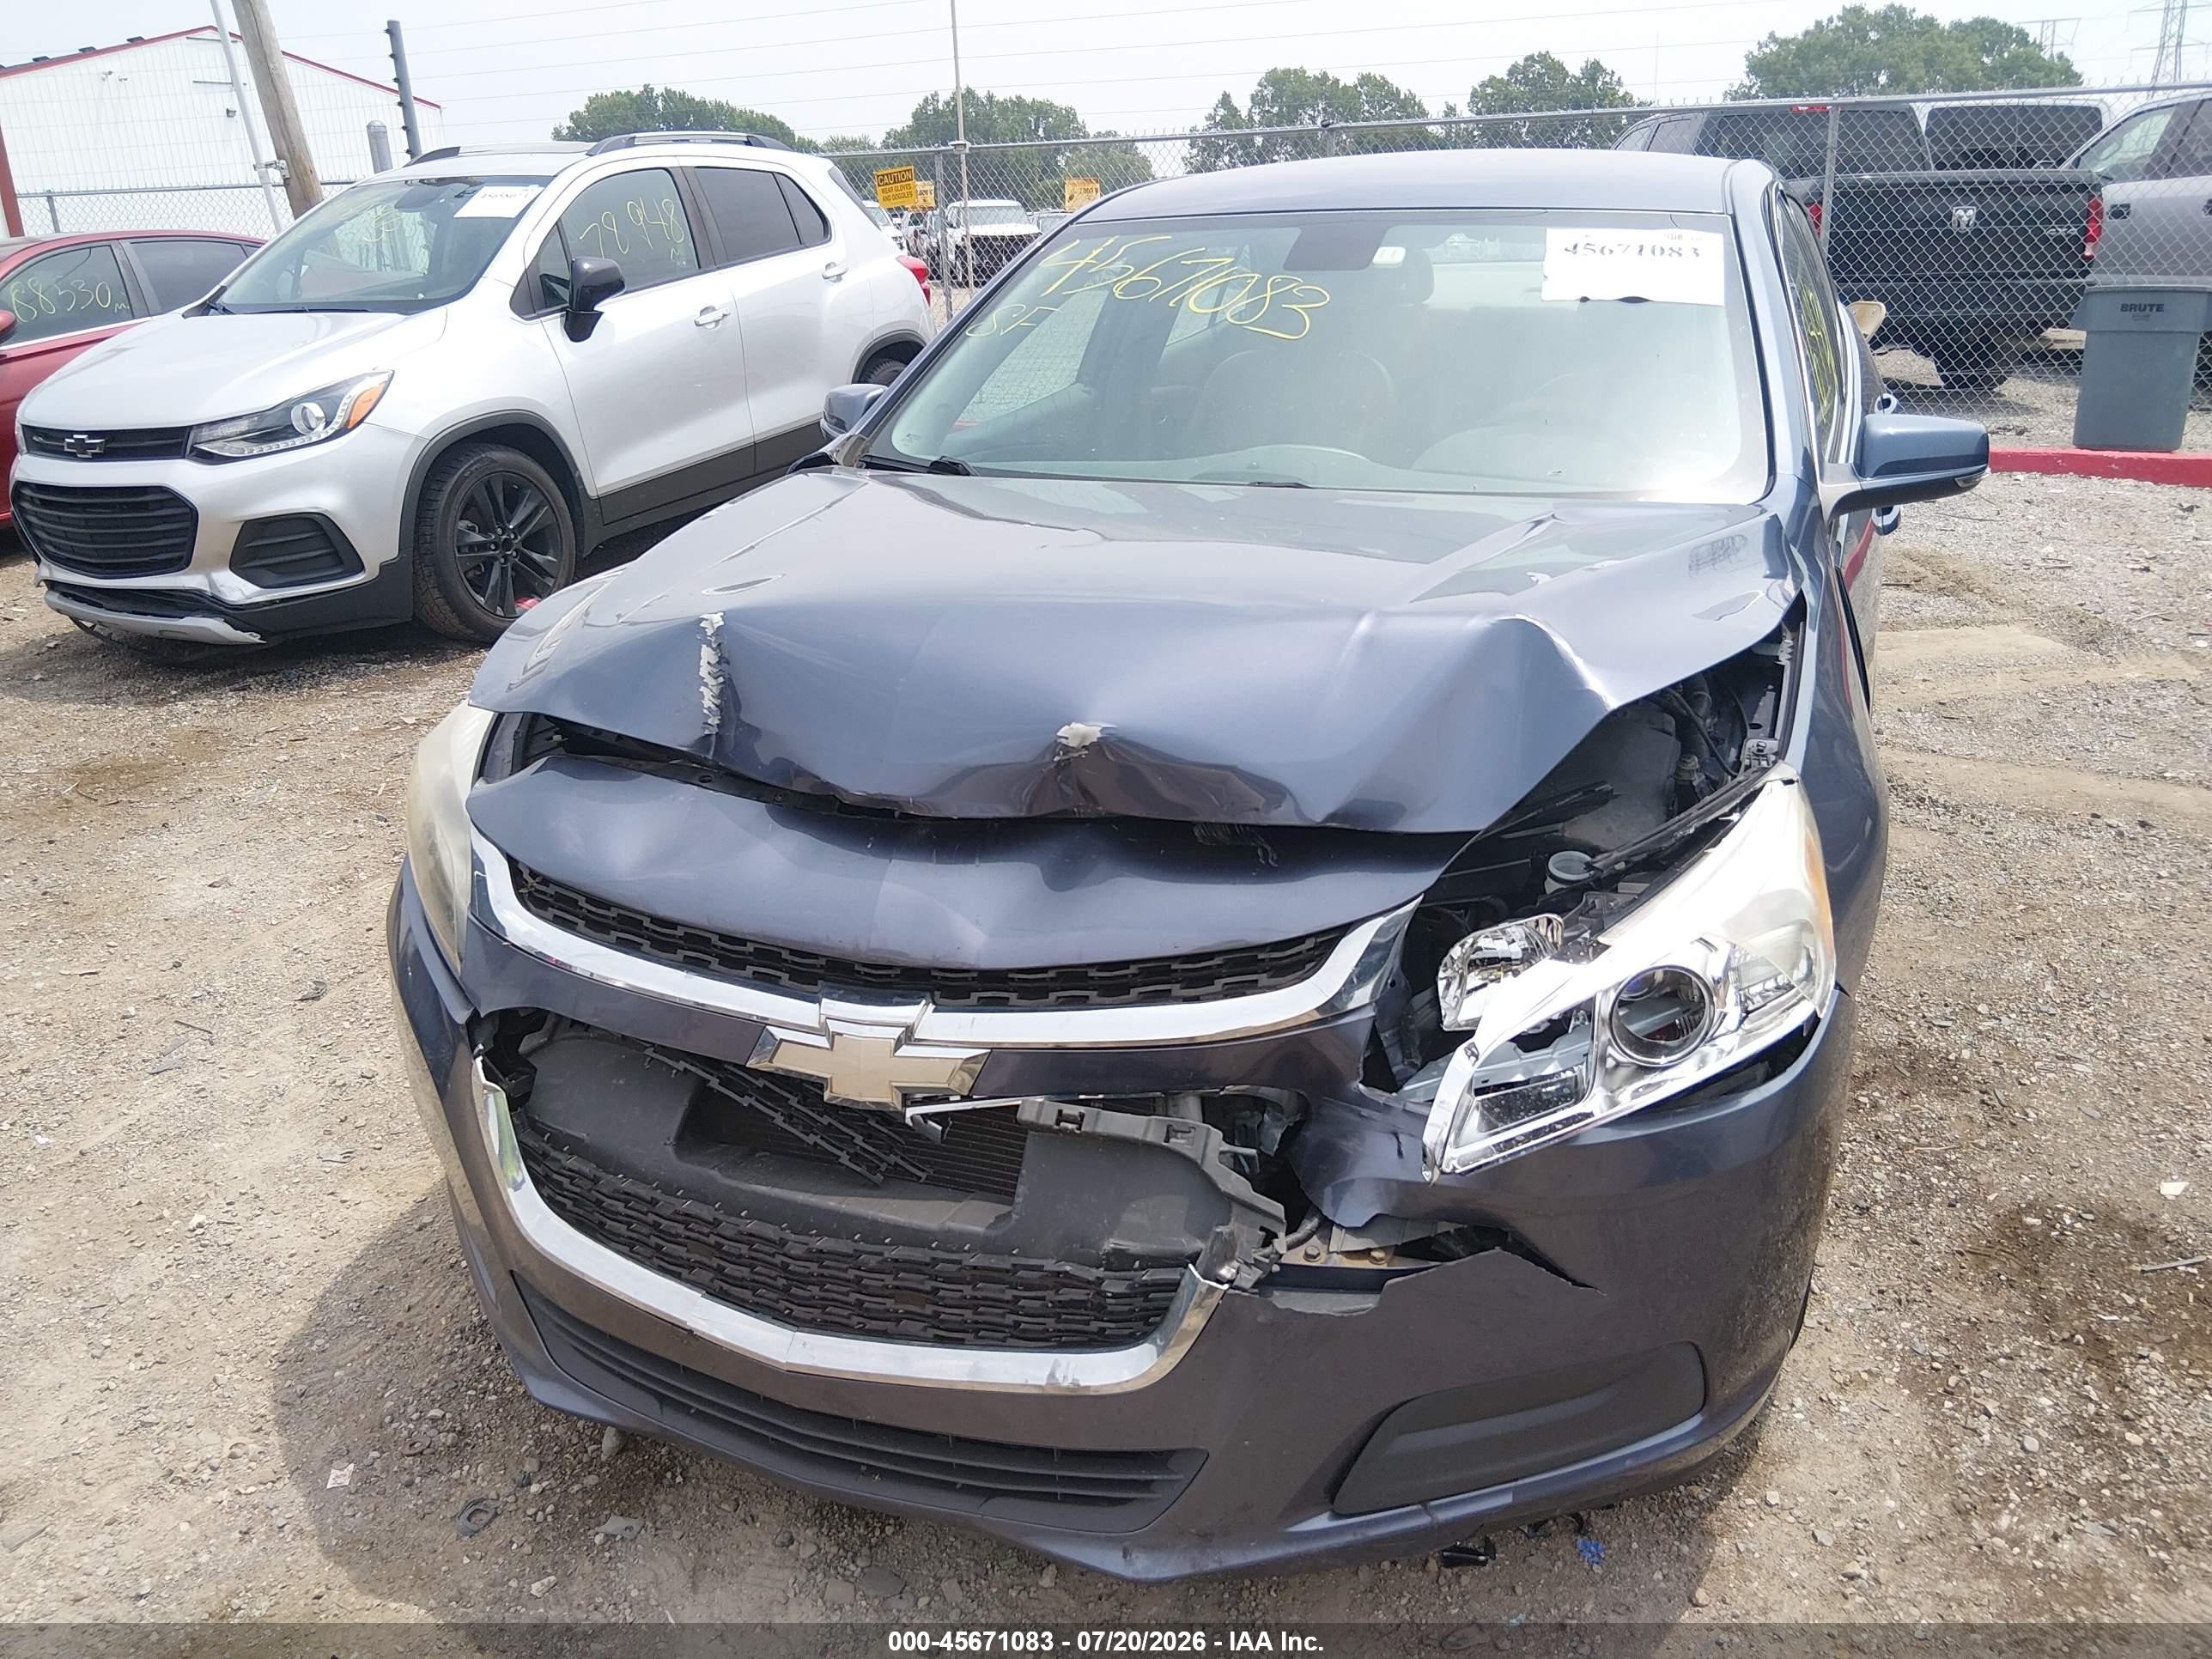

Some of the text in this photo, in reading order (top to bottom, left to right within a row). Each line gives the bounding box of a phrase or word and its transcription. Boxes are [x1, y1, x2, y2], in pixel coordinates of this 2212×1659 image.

[878, 171, 912, 185] CAUTION
[894, 184, 912, 192] GLOVES
[1564, 242, 1700, 258] 45671083
[1038, 235, 1330, 340] 45671083
[9, 275, 112, 323] 88530
[2119, 303, 2165, 313] BRUTE
